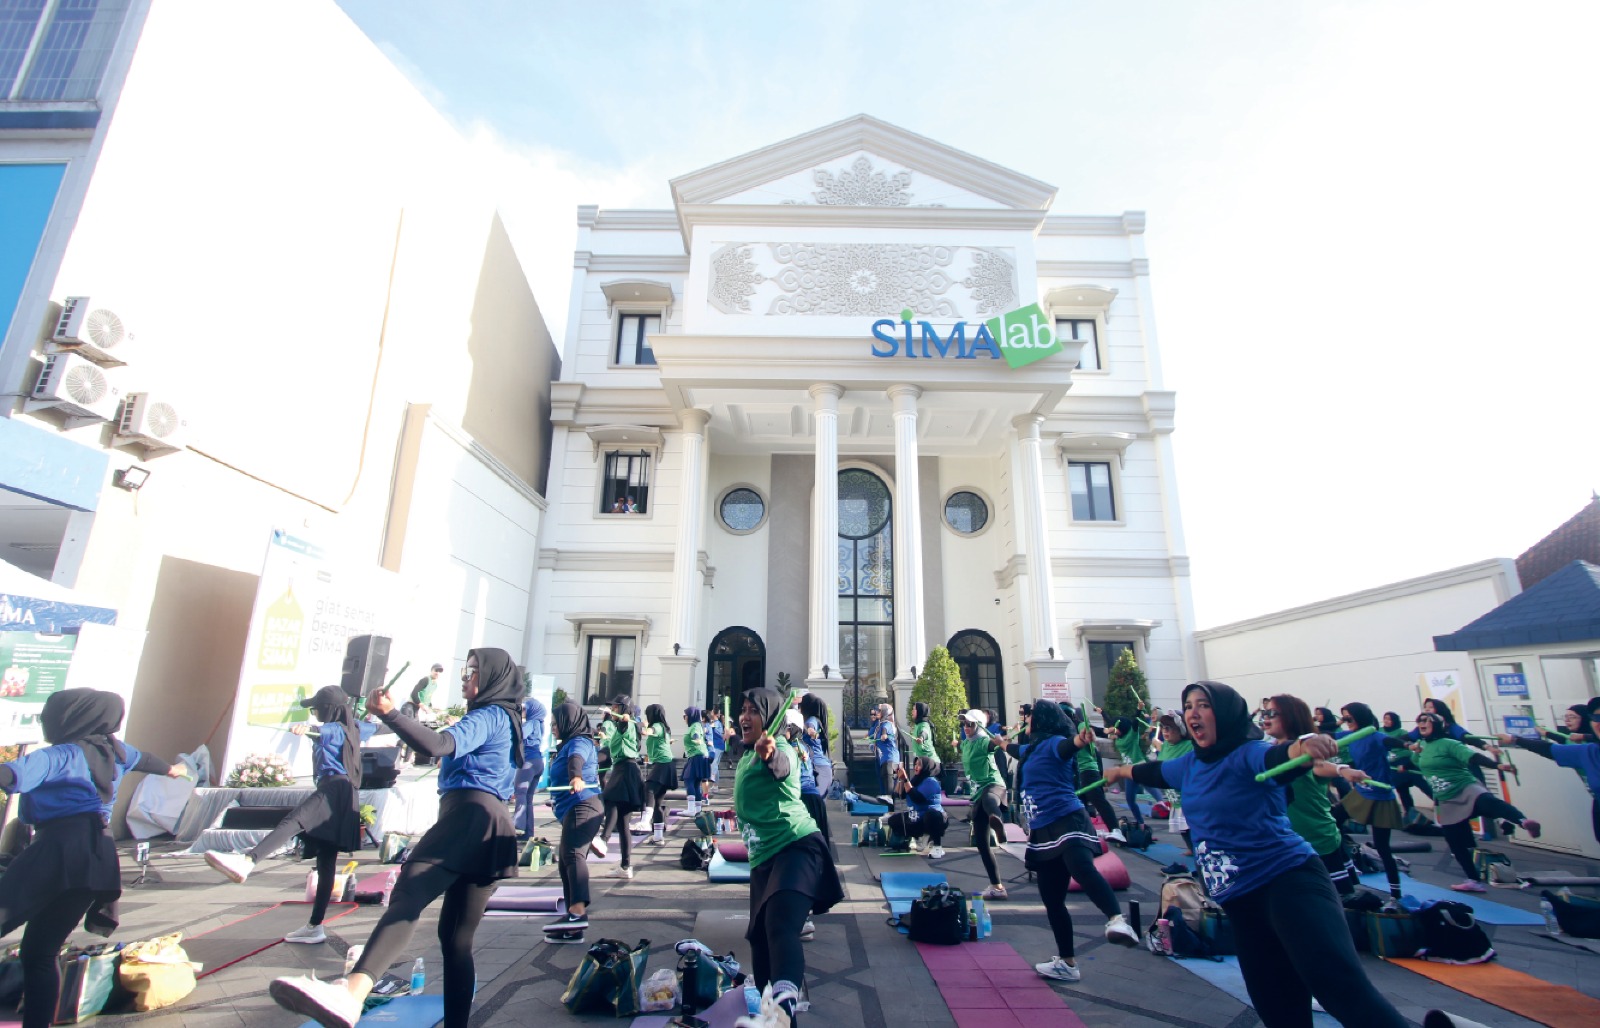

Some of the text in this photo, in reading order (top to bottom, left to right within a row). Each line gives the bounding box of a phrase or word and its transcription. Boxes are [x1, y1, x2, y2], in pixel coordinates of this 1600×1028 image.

[999, 314, 1056, 349] lab
[266, 617, 302, 633] BAZAR
[264, 632, 300, 649] SEHAT
[261, 646, 295, 666] SIMA
[1500, 676, 1521, 684] POS
